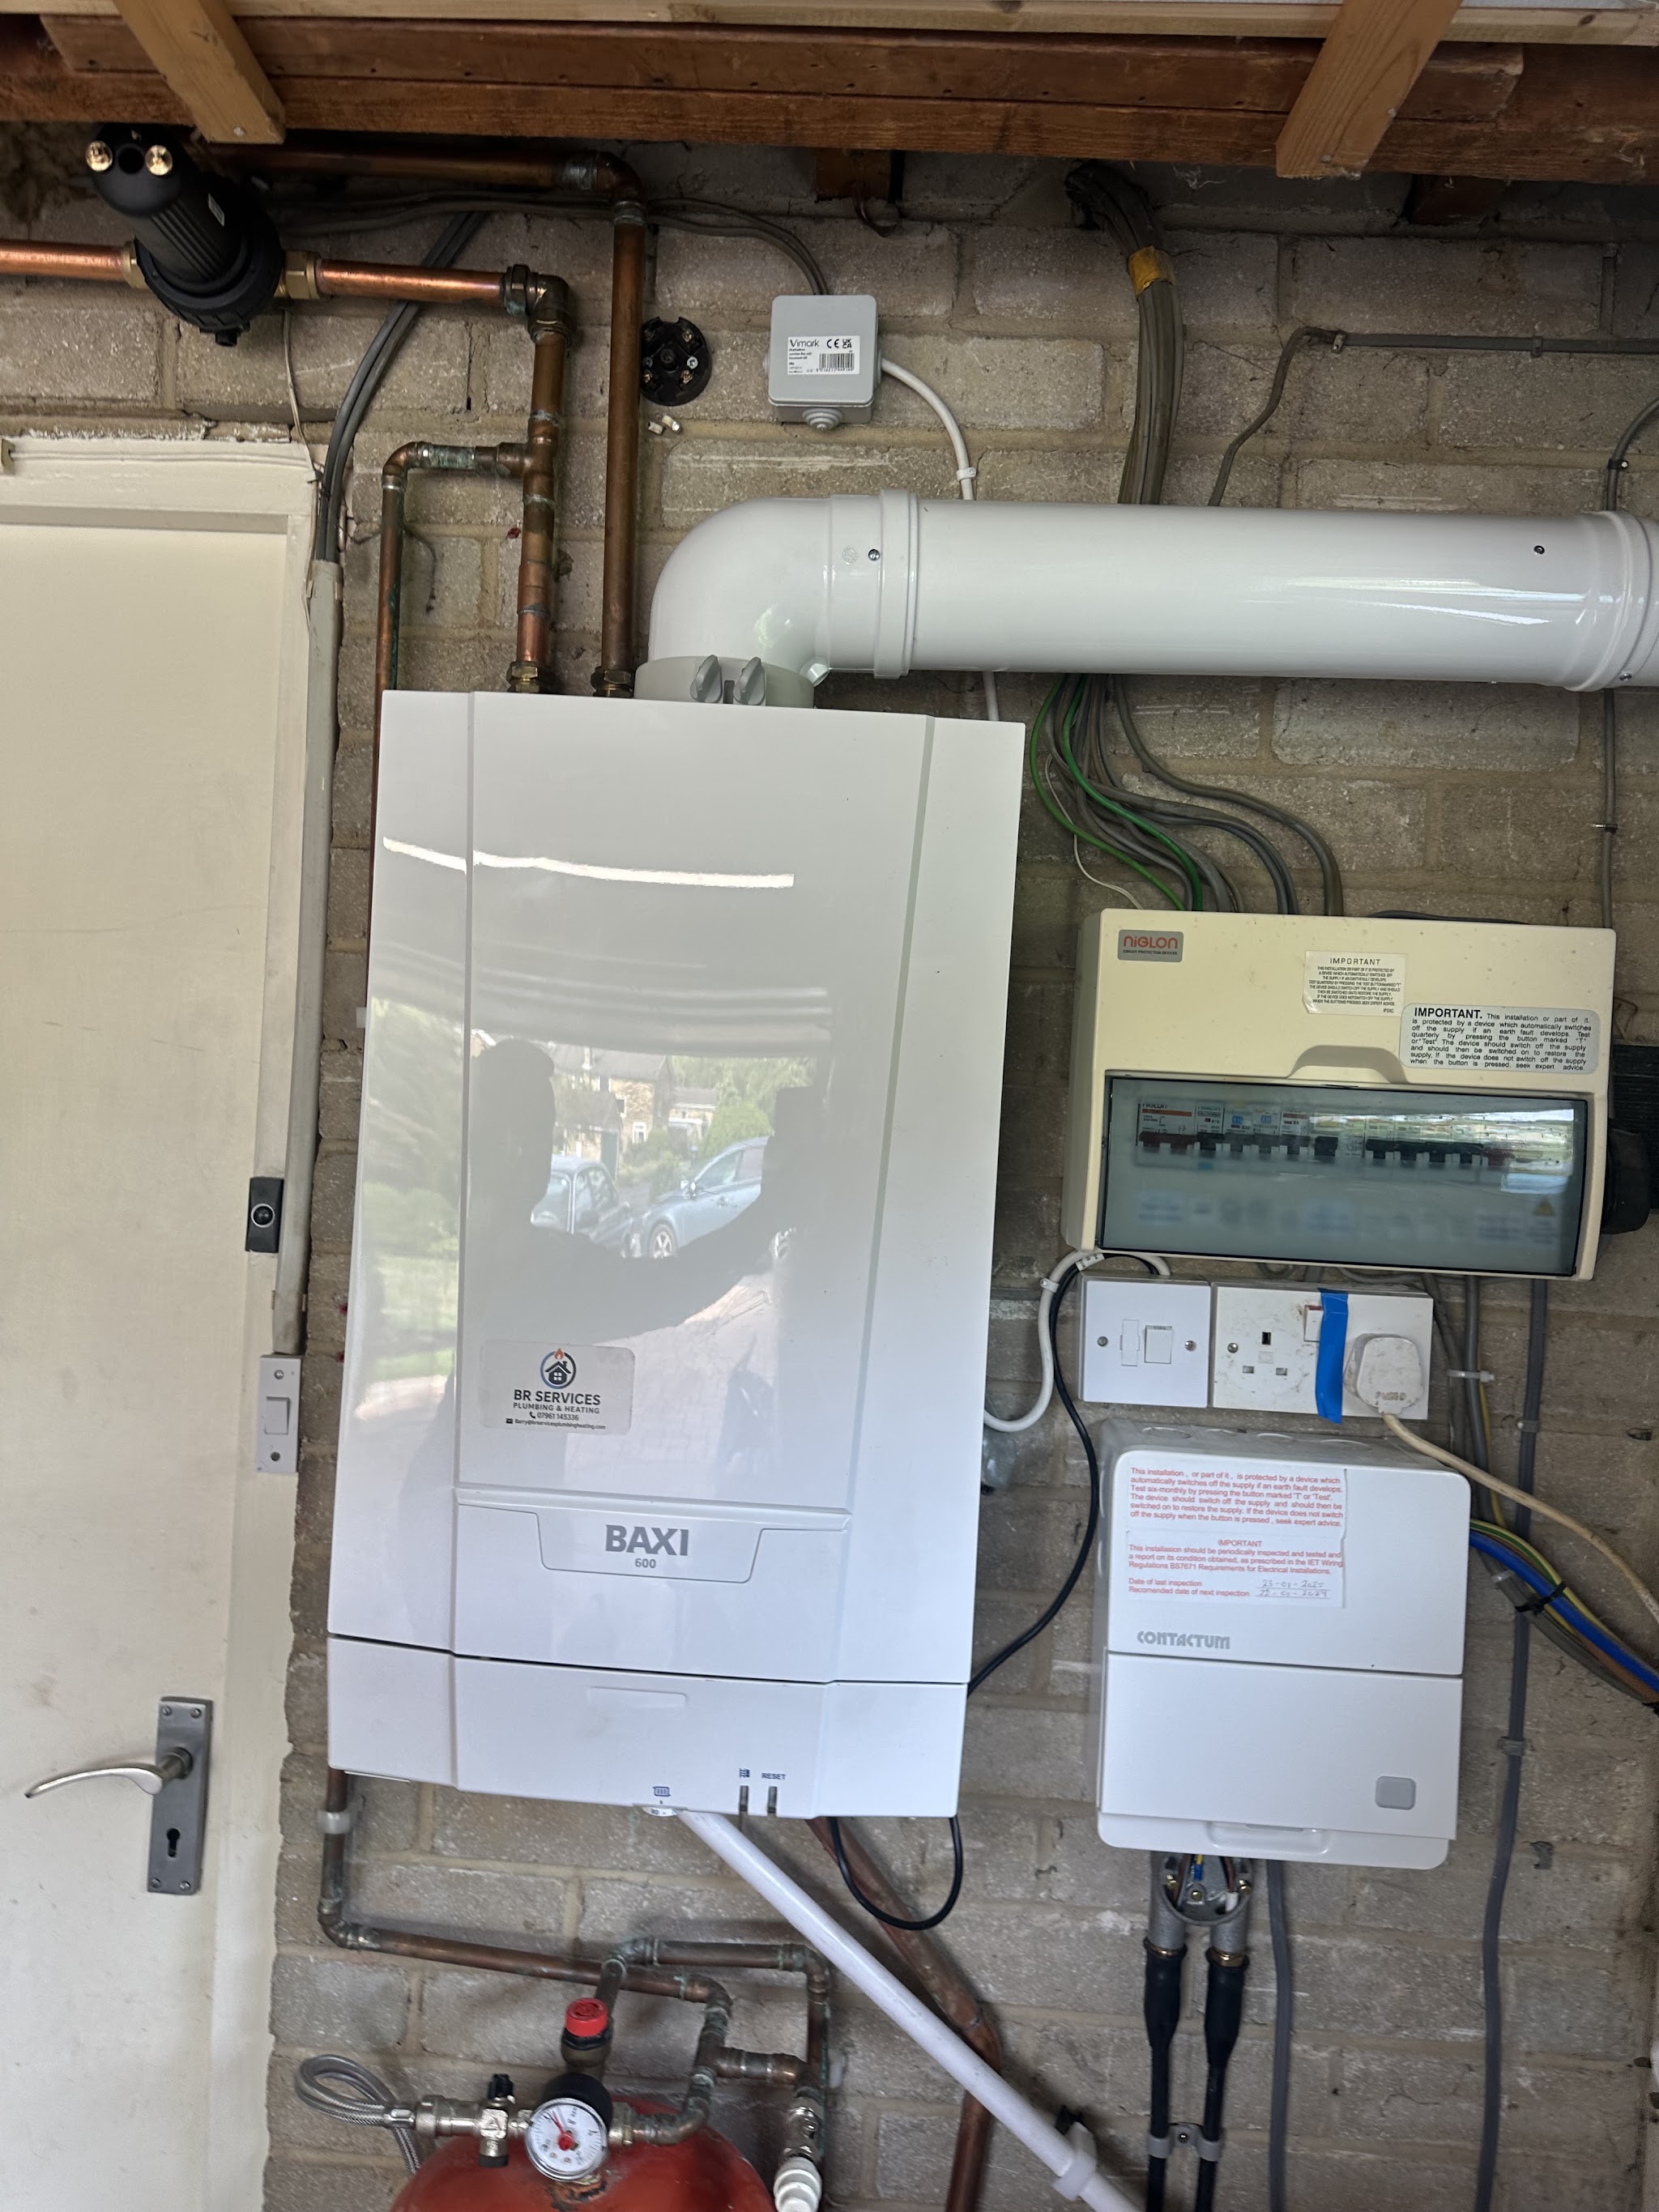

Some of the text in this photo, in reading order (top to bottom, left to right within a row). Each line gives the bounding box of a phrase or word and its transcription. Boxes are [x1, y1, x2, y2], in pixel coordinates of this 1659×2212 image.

[1414, 1008, 1482, 1019] IMPORTANT.
[514, 1389, 601, 1405] BR SERVICES
[513, 1403, 554, 1411] PLUMBING
[1131, 1477, 1175, 1485] automatically
[1148, 1485, 1186, 1494] six-monthly
[605, 1524, 689, 1556] BAXI
[635, 1558, 656, 1568] 600
[1137, 1630, 1230, 1649] CONTACTUM
